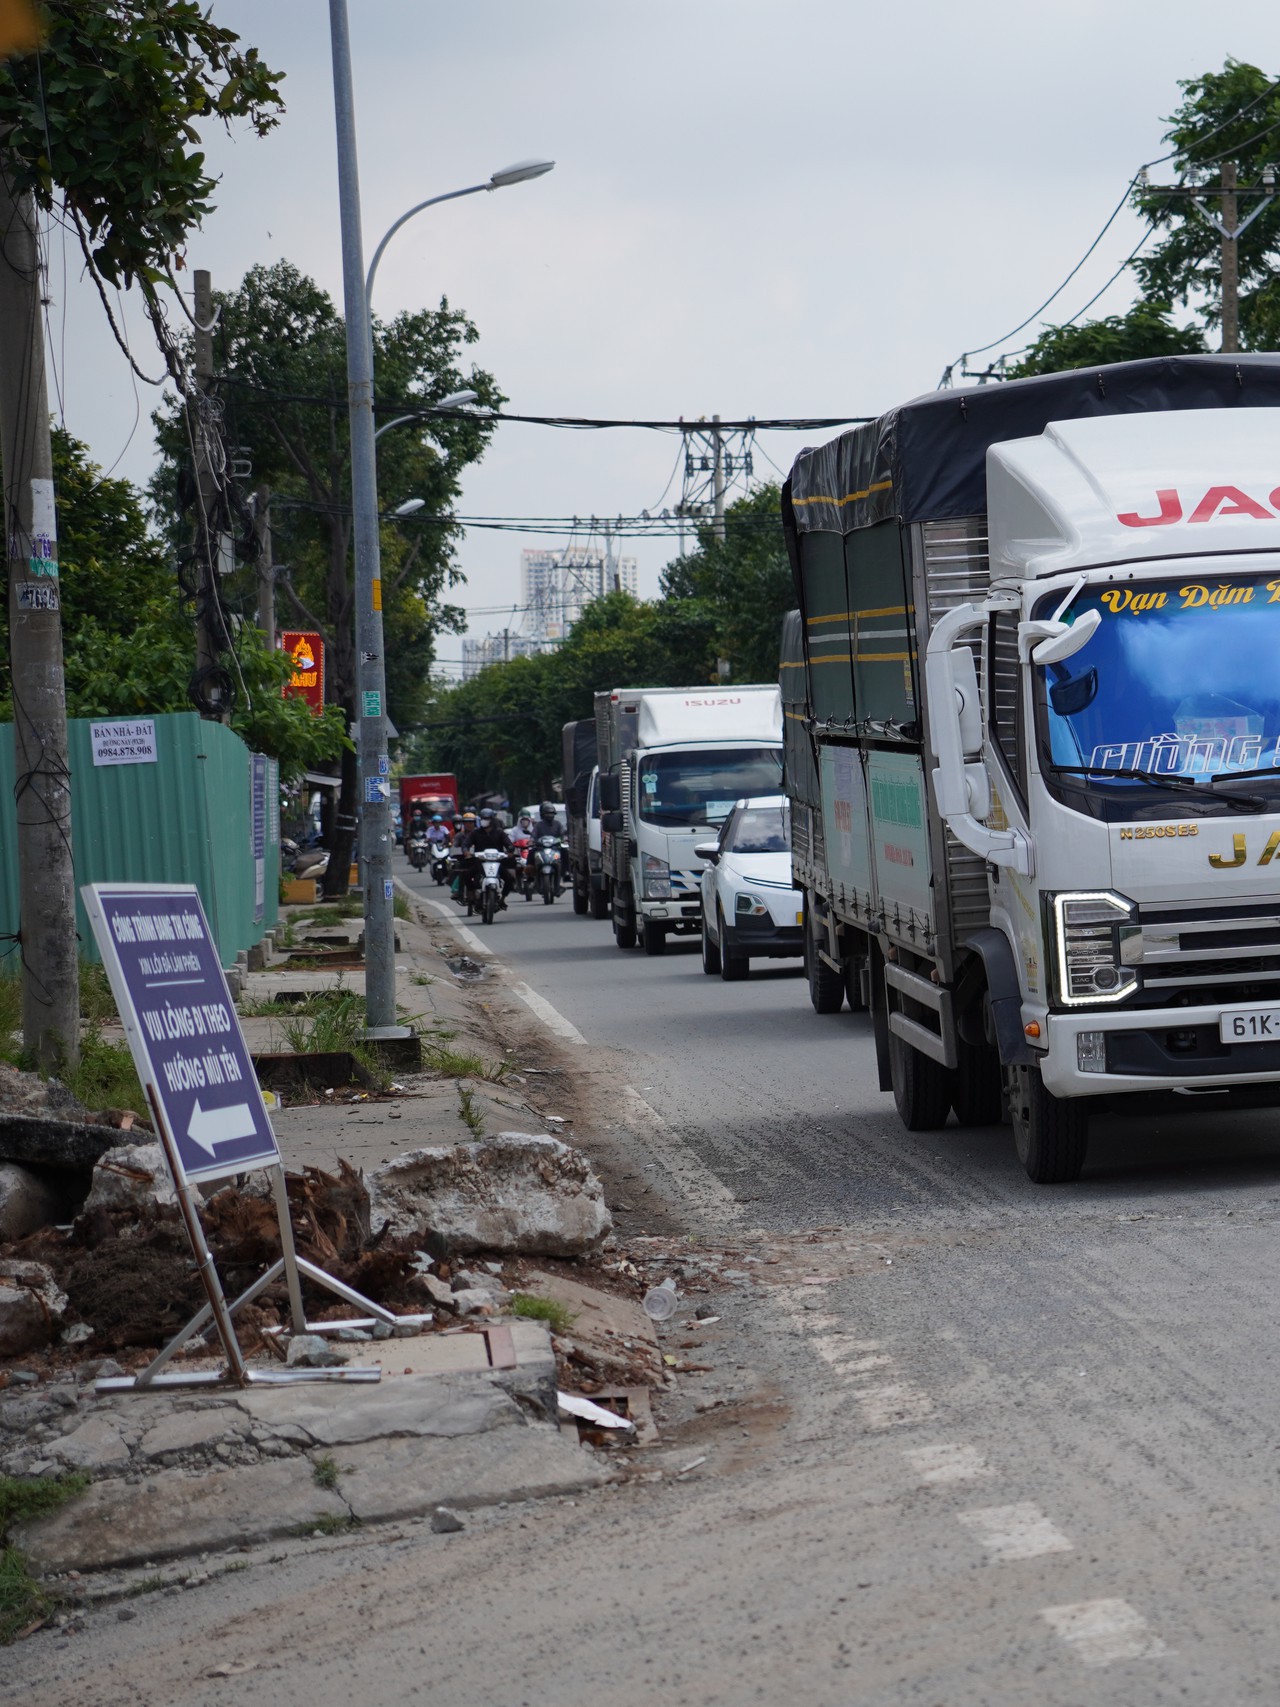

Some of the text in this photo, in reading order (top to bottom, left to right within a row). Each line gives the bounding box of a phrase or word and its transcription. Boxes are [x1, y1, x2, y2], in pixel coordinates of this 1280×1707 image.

[1101, 588, 1170, 616] Vạn
[1179, 583, 1256, 611] Dặm
[684, 698, 741, 707] ISUZU
[94, 726, 111, 738] BÁN
[98, 745, 152, 757] 0984.878.908
[142, 999, 231, 1042] VUI LÒNG ĐI THEO
[163, 1044, 242, 1092] HƯỚNG MŨI TÊN
